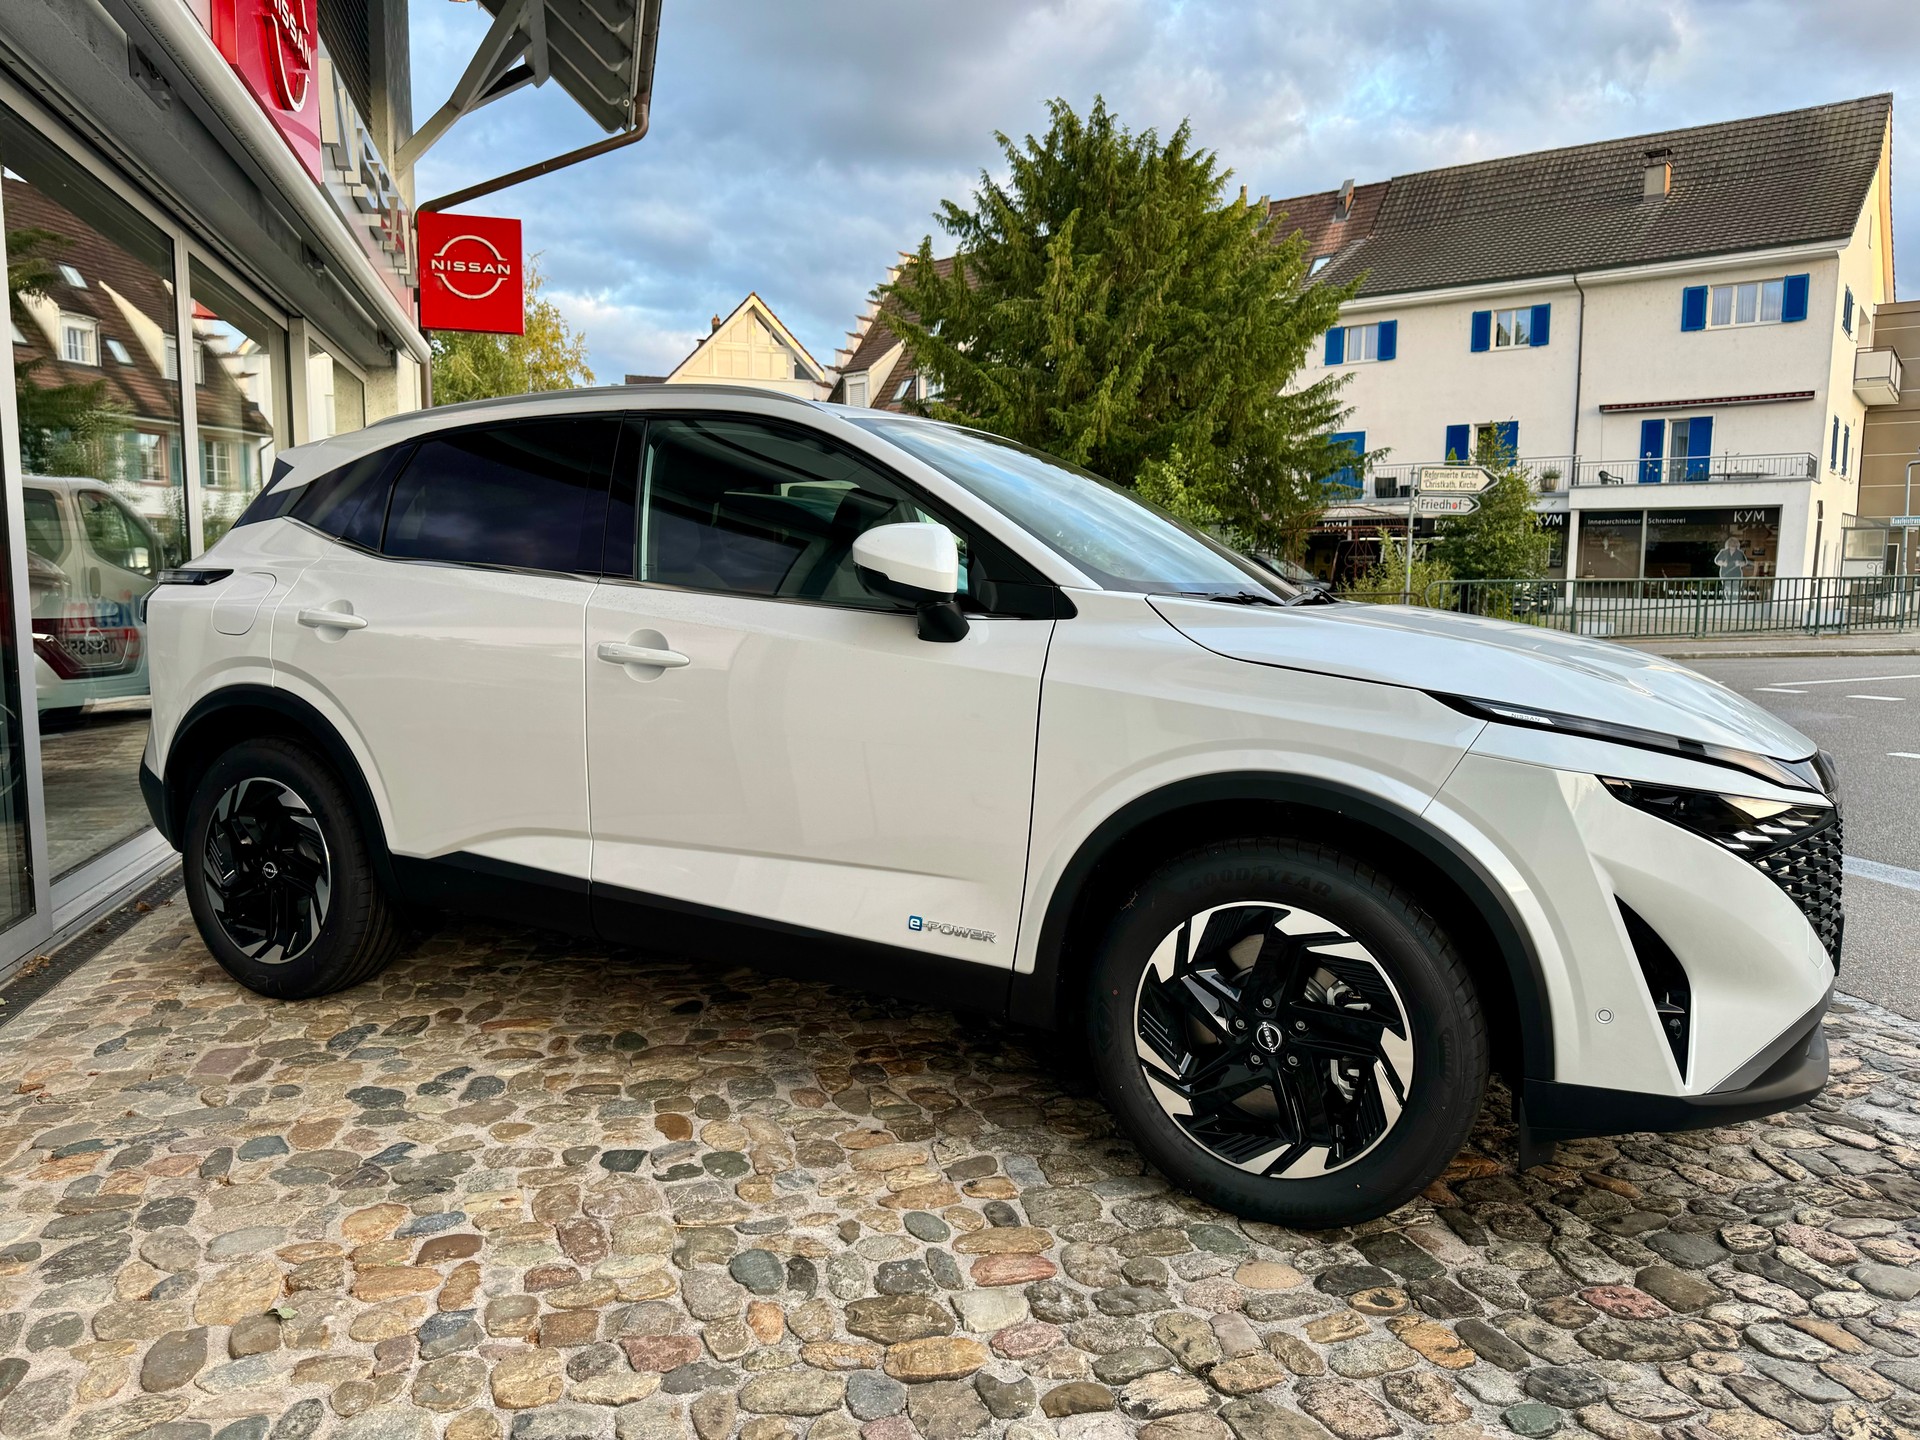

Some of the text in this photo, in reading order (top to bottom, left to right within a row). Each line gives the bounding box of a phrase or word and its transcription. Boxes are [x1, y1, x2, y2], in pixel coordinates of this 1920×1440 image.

[273, 0, 312, 71] ISSAN
[431, 259, 511, 275] NISSAN
[1424, 470, 1479, 480] Reformierte Kirche
[1458, 481, 1477, 489] Kirche
[1420, 498, 1463, 510] Friedhof
[1535, 514, 1563, 526] KYM
[1587, 517, 1686, 526] Innenarchitektur Schreinerei
[1734, 510, 1765, 523] KYM
[1511, 713, 1541, 721] NISSAN
[908, 915, 998, 944] e-POWER
[1261, 1021, 1276, 1053] NISSAN
